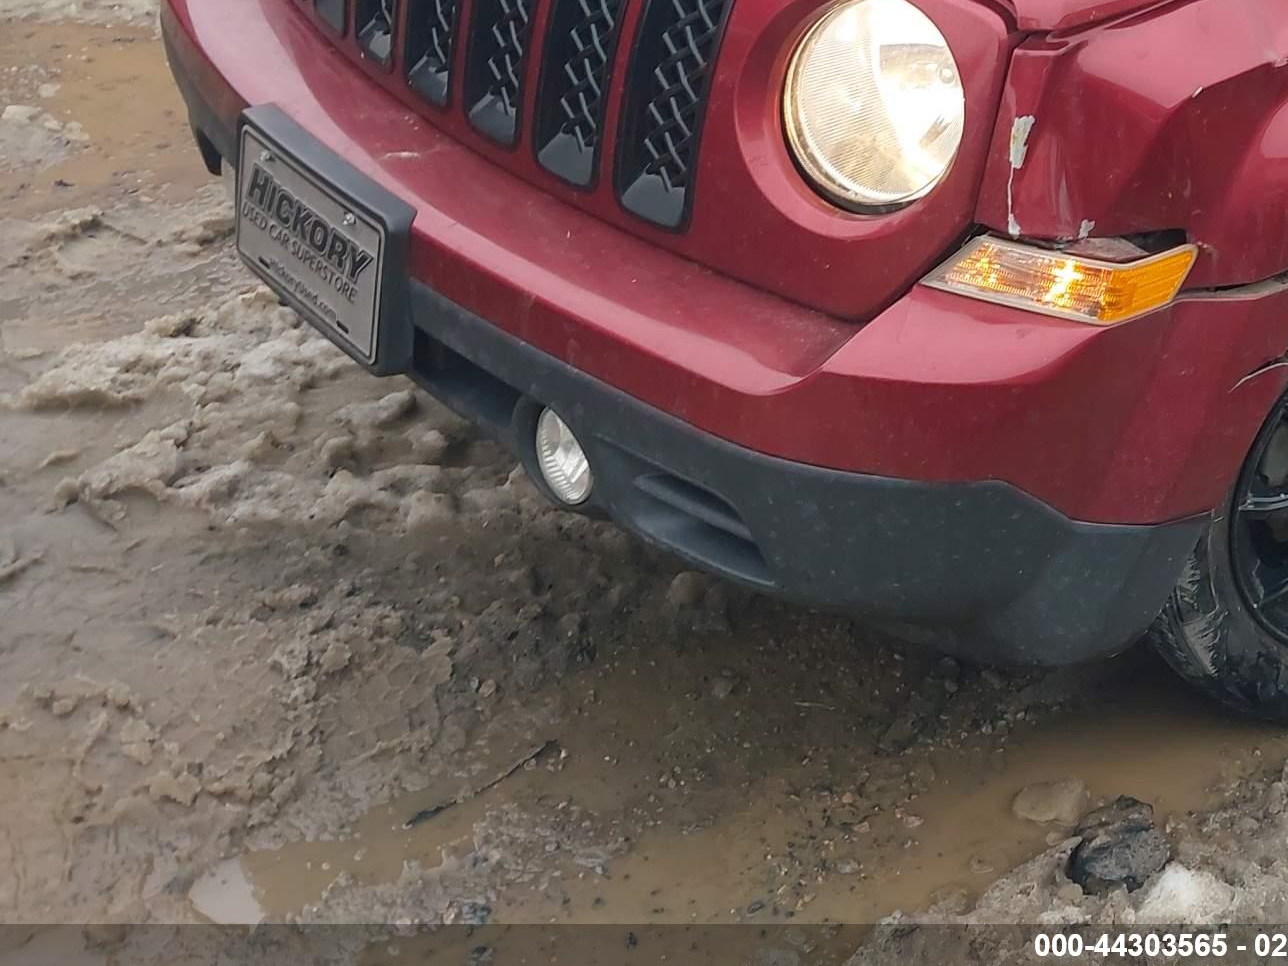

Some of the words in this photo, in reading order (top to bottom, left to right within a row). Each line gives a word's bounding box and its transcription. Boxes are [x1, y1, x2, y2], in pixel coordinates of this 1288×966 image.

[242, 201, 268, 231] USED
[269, 222, 291, 250] CAR
[290, 240, 359, 302] SUPERSTORE
[246, 162, 374, 284] HICKORY
